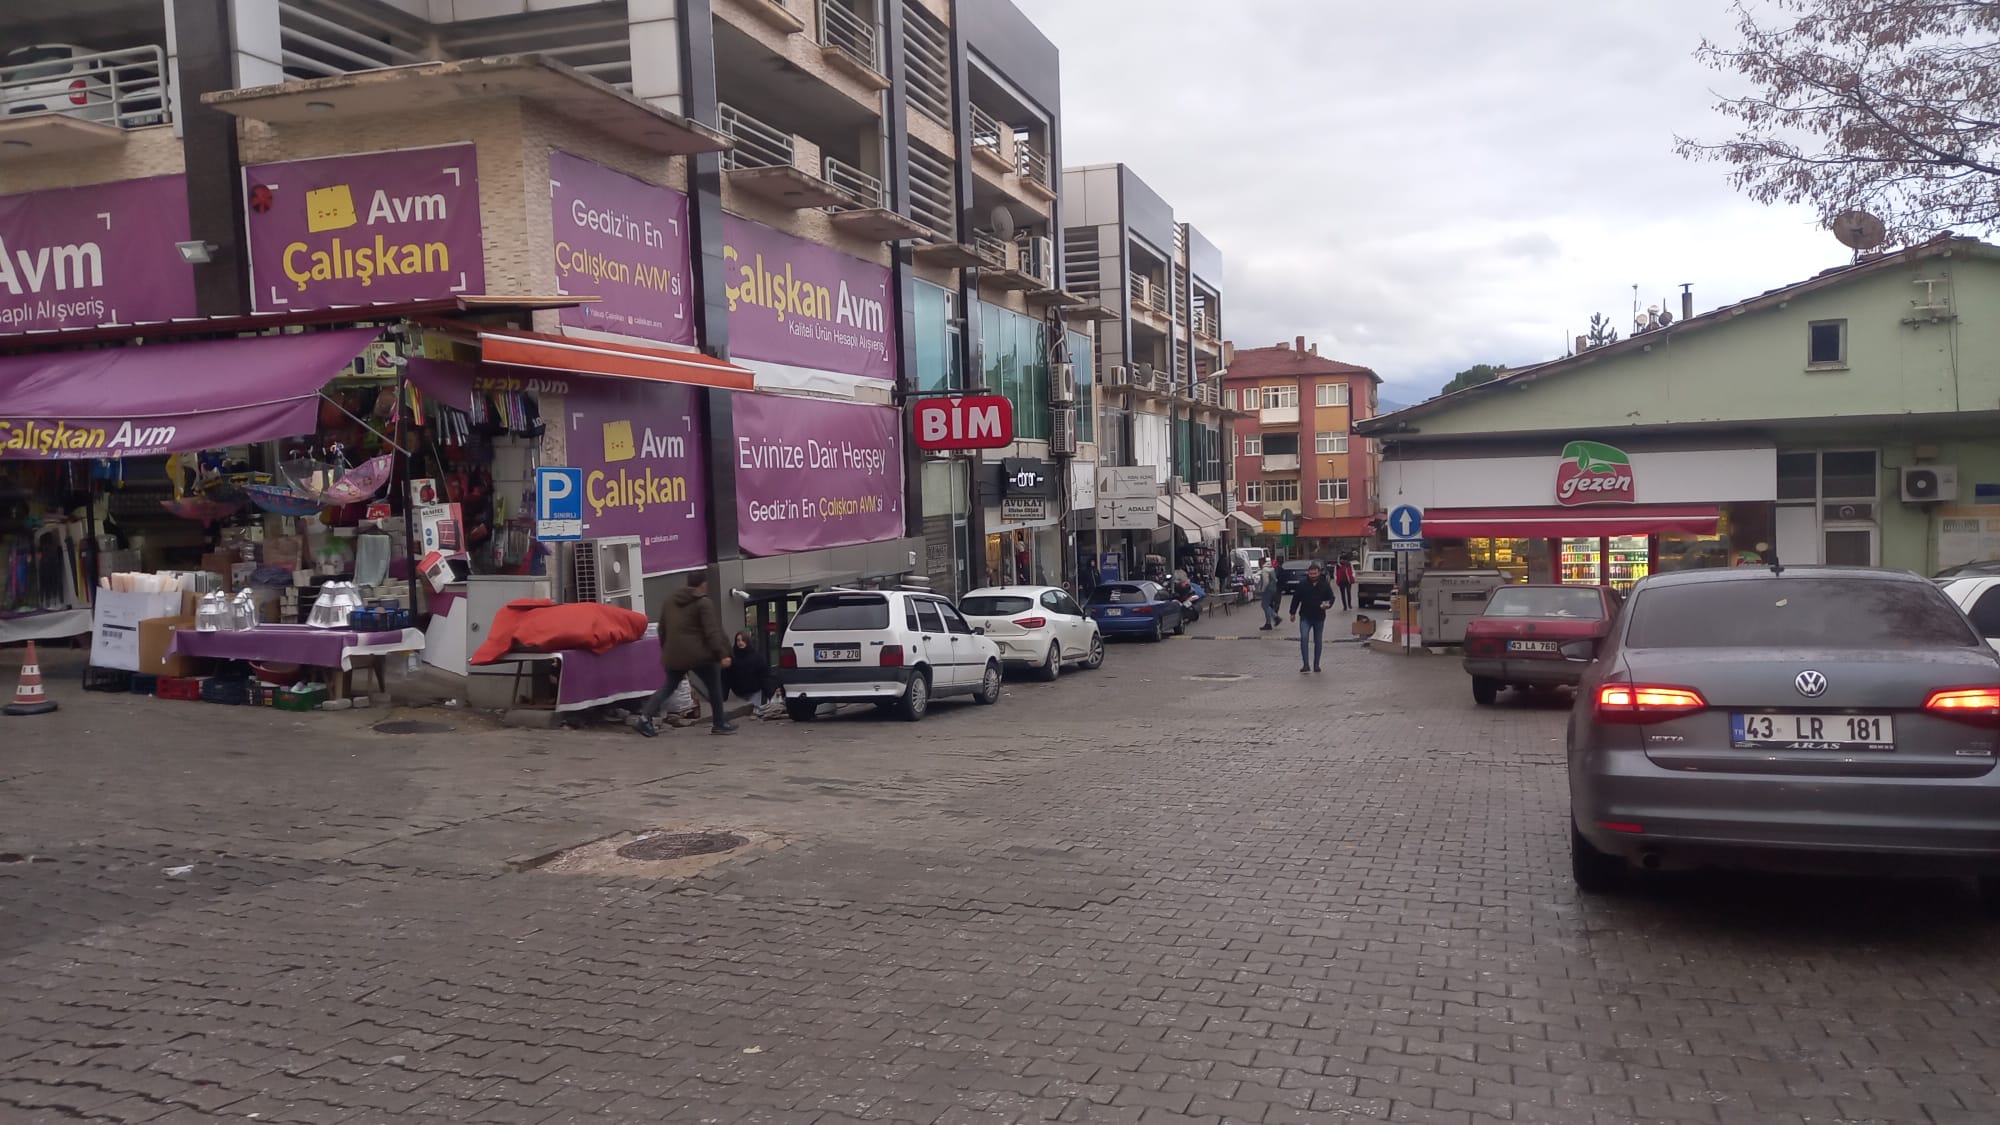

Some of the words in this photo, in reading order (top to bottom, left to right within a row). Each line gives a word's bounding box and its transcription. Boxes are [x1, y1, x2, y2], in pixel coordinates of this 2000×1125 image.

[367, 190, 446, 225] Avm
[572, 199, 640, 243] Gediz'in
[644, 221, 663, 249] En
[282, 235, 449, 291] Çalışkan
[556, 242, 630, 284] Çalışkan
[634, 262, 681, 296] AVM'si
[37, 297, 105, 321] Alışveriş
[836, 279, 884, 333] Avm
[788, 319, 814, 339] Kaliteli
[815, 323, 833, 342] Ürün
[833, 331, 859, 349] Hesaplı
[107, 421, 176, 448] Avm
[922, 398, 1002, 441] BİM
[641, 427, 684, 459] Avm
[739, 436, 804, 469] Evinize
[808, 439, 838, 469] Dair
[841, 441, 886, 475] Herşey
[542, 472, 572, 519] P
[586, 467, 686, 517] Çalışkan
[1560, 475, 1632, 498] gezen
[749, 499, 799, 522] Gediz'in
[803, 499, 816, 518] En
[819, 495, 859, 522] Çalışkan
[1004, 499, 1043, 507] AVUKAT
[832, 650, 841, 658] SP
[1746, 717, 1774, 739] 43
[1796, 717, 1824, 740] LR
[1846, 718, 1881, 741] 181
[1785, 742, 1841, 750] ARAS
